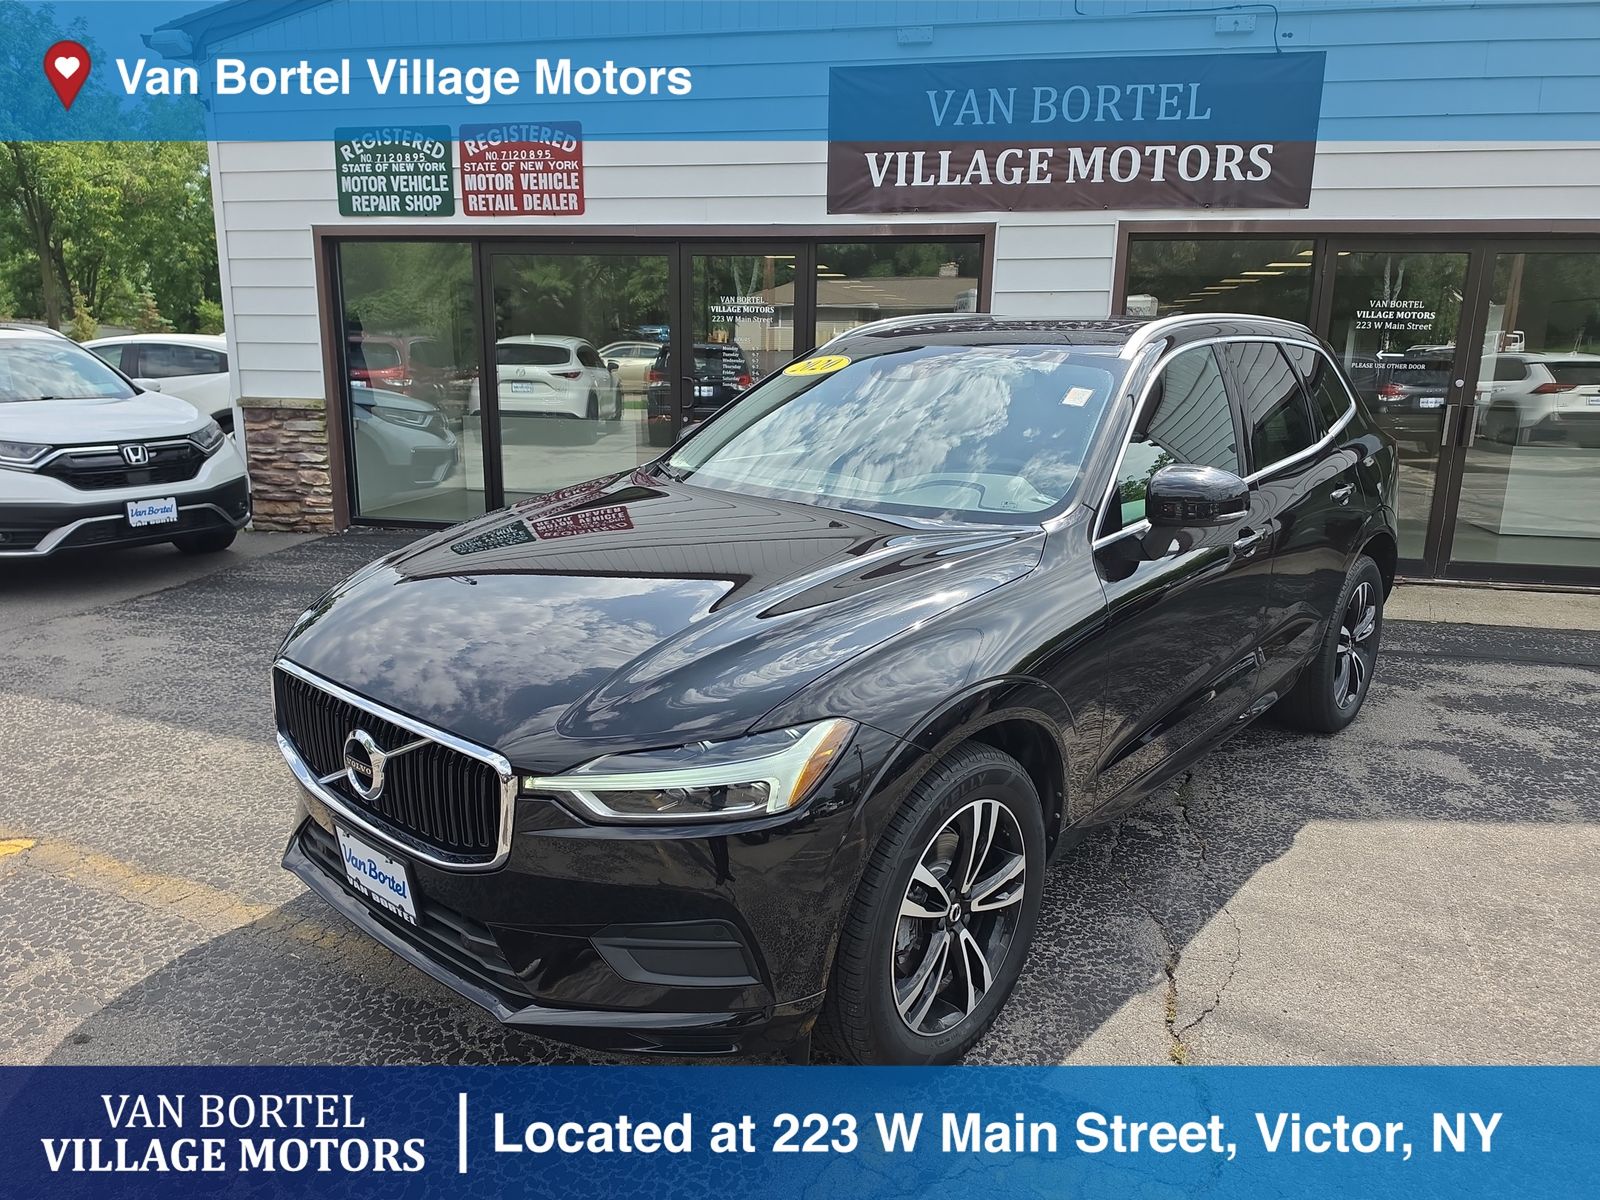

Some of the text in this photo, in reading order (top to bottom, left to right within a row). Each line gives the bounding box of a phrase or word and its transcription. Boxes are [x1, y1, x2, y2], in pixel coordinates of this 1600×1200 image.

[926, 82, 1212, 126] VAN BORTEL
[340, 128, 445, 161] REGISTERED
[464, 125, 577, 156] REGISTERED
[376, 153, 426, 162] 7120895
[501, 150, 551, 159] 7120895
[342, 162, 446, 173] STATE OF NEW YORK
[464, 161, 579, 171] STATE OF NEW YORK
[865, 145, 1273, 187] VILLAGE MOTORS
[341, 175, 449, 192] MOTOR VEHICLE
[464, 172, 579, 191] MOTOR VEHICLE
[352, 195, 442, 212] REPAIR SHOP
[468, 193, 578, 211] RETAIL DEALER
[1370, 300, 1424, 309] VAN BORTEL
[1356, 311, 1436, 320] VILLAGE MOTORS
[1356, 321, 1371, 329] 223
[1384, 322, 1405, 330] Main
[1407, 322, 1432, 330] Street
[131, 504, 174, 517] Van Bortel
[346, 757, 372, 775] VOLVO
[342, 843, 407, 899] Van Bortel
